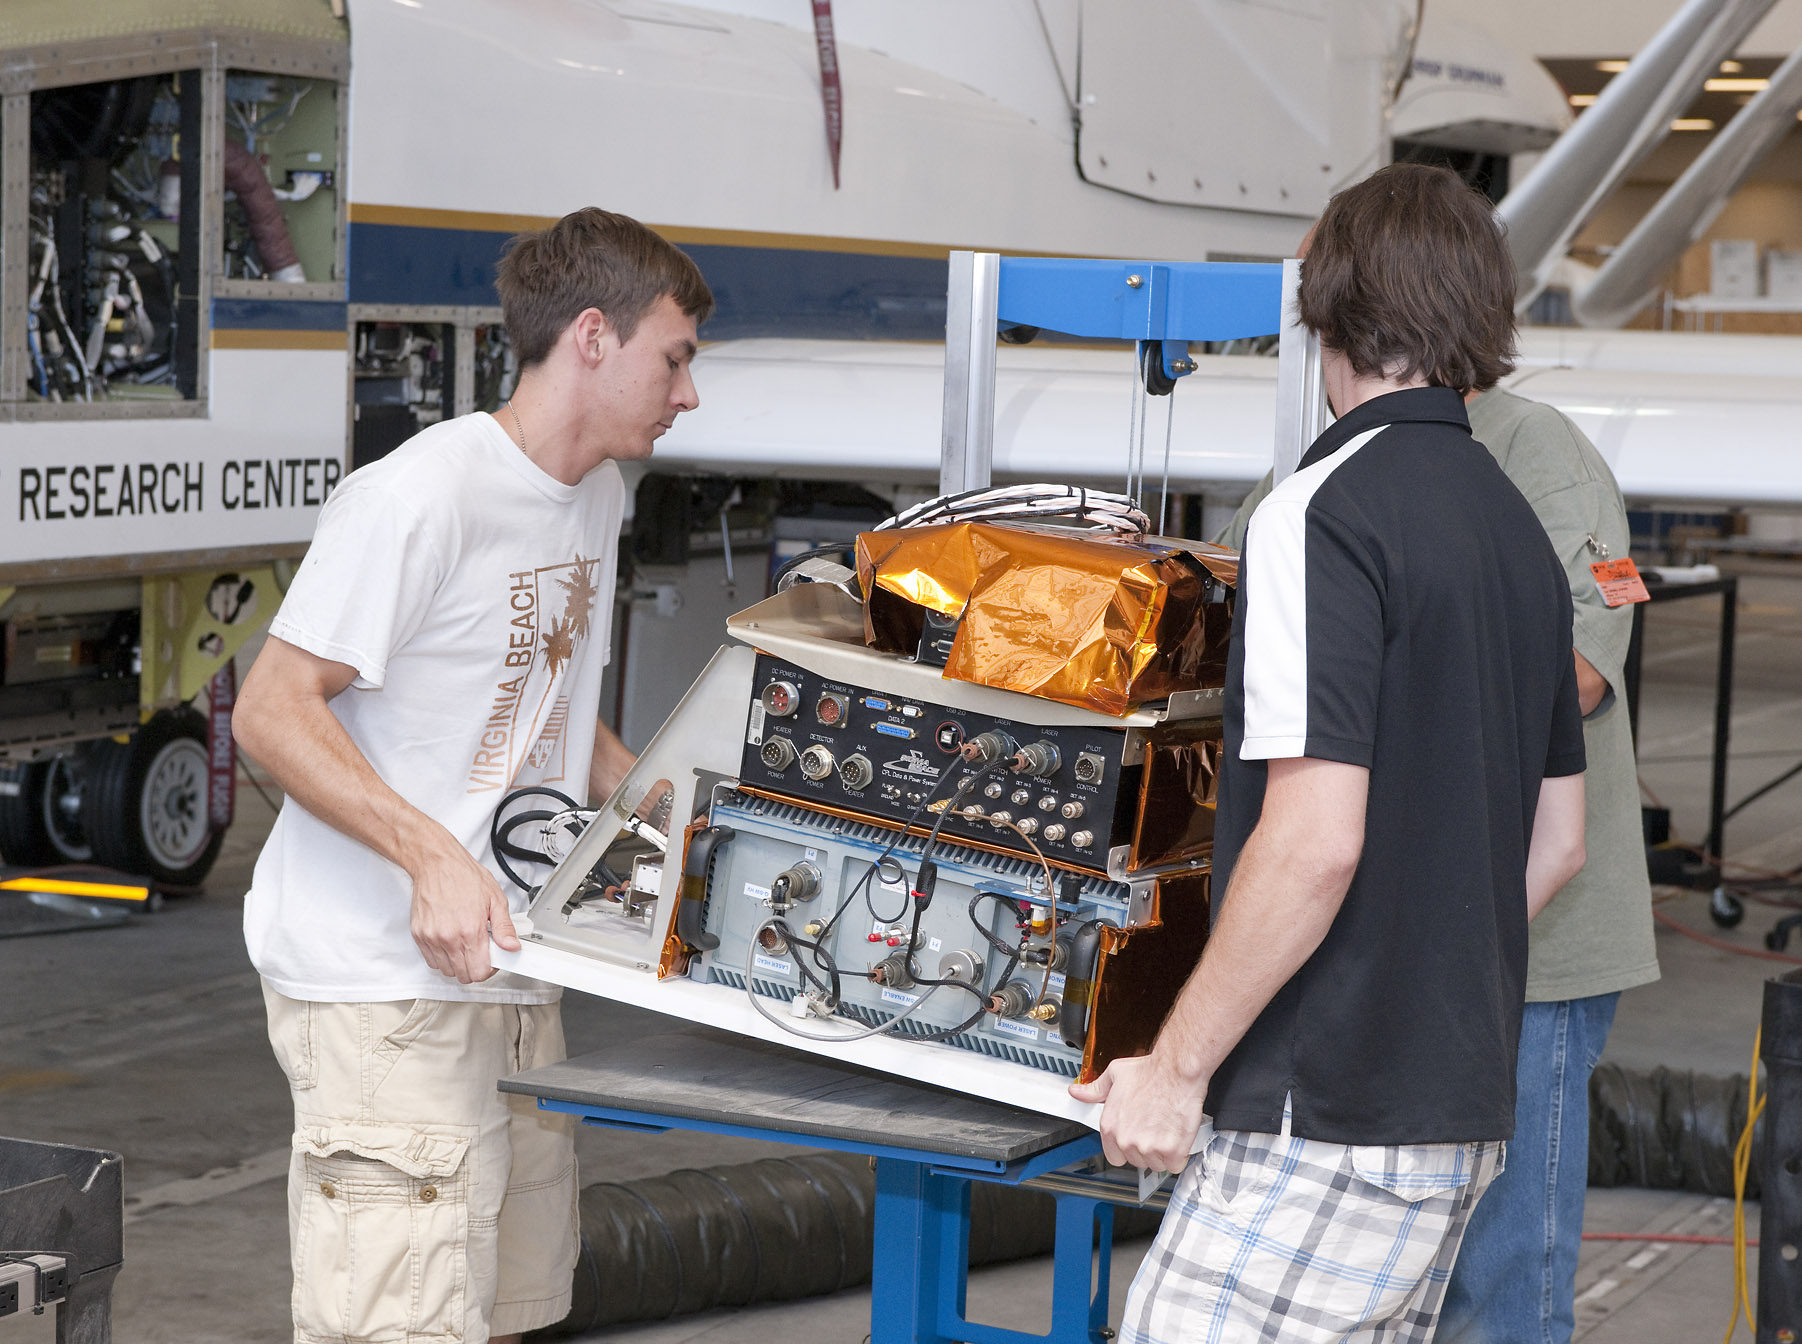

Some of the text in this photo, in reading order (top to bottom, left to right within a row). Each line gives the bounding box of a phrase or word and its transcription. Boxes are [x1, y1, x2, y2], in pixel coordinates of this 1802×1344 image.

[19, 457, 341, 521] RESEARCH CENTER
[771, 667, 779, 675] DC
[779, 669, 797, 679] POWER
[466, 571, 536, 795] VIRGINIA BEACH
[829, 683, 847, 693] POWER
[946, 707, 967, 717] USB 2.0
[887, 715, 900, 724] DATA
[994, 717, 1012, 727] LASER
[773, 725, 792, 735] HEATER
[1041, 728, 1059, 737] LASER
[212, 711, 231, 768] BEFORE
[809, 733, 834, 744] DETECTOR
[856, 744, 867, 752] AUX
[1085, 743, 1102, 753] PILOT
[767, 770, 785, 780] POWER
[892, 771, 903, 779] Data
[908, 775, 921, 784] Power
[1033, 775, 1052, 785] POWER
[806, 780, 824, 789] POWER
[1076, 783, 1099, 794] CONTROL
[845, 789, 865, 799] HEATER
[756, 957, 789, 969] LASER HEAD
[883, 990, 906, 1001] ENABLE
[997, 1021, 1036, 1036] LASER POWER
